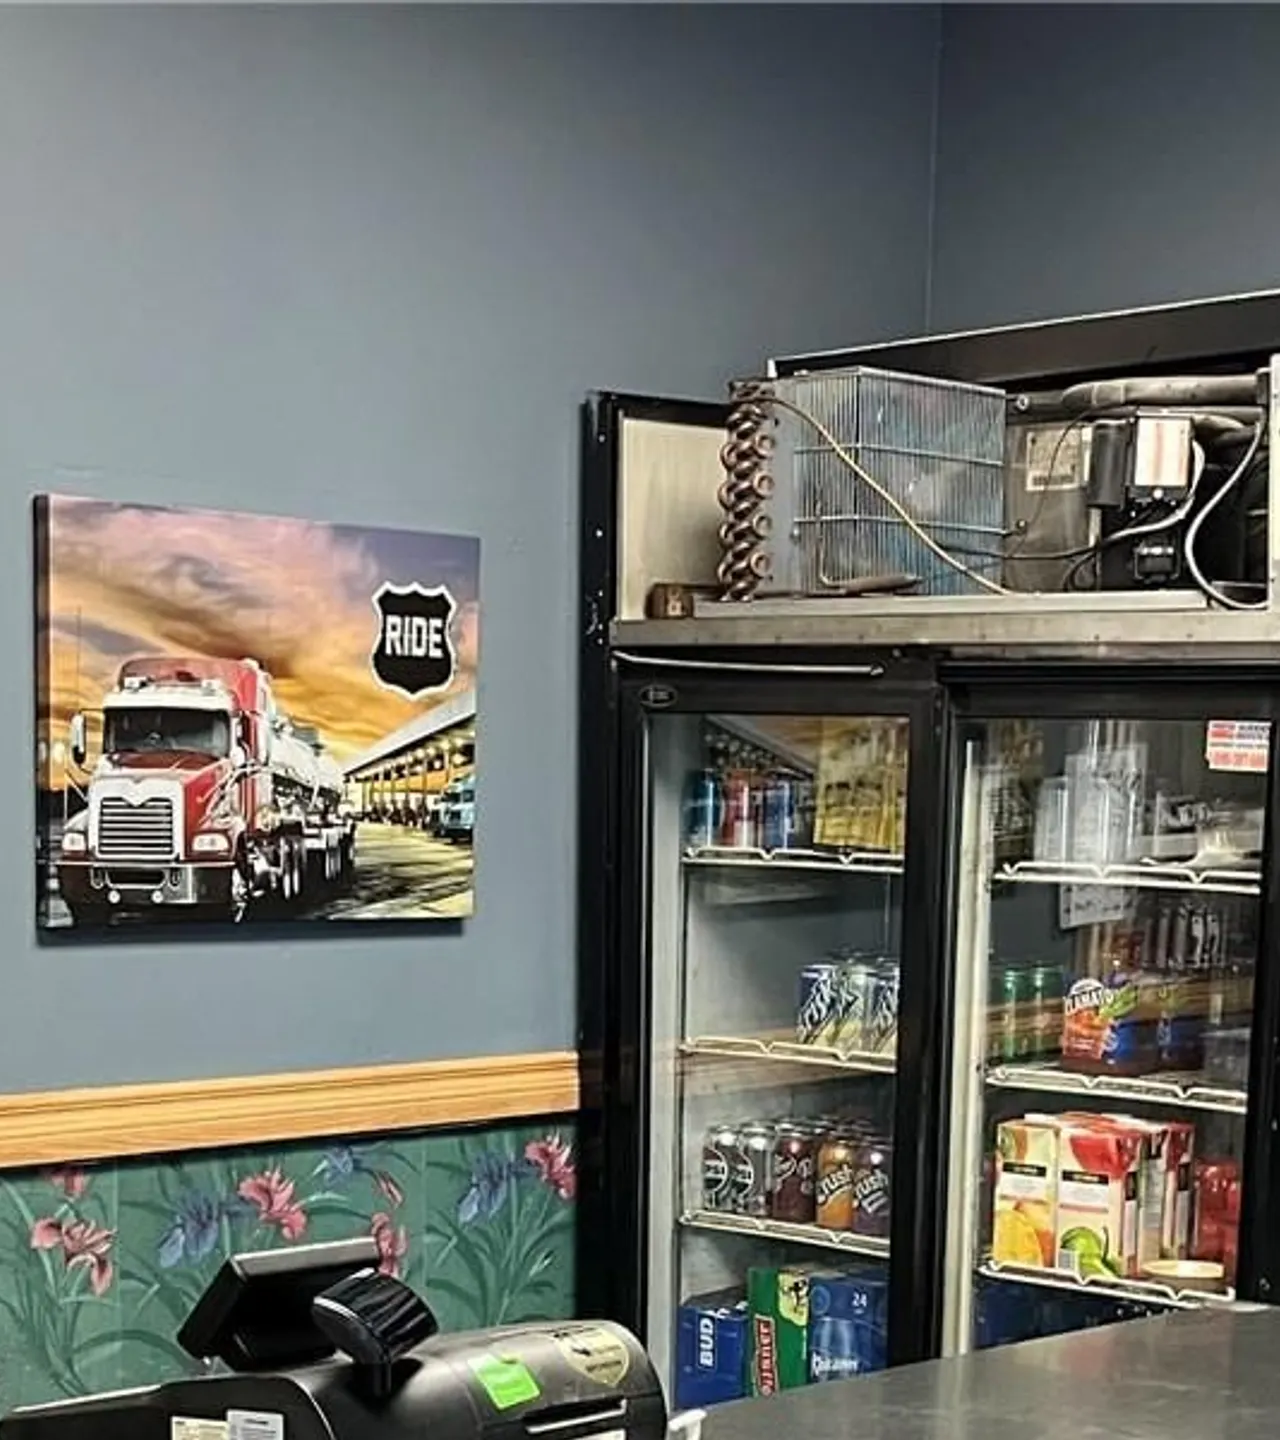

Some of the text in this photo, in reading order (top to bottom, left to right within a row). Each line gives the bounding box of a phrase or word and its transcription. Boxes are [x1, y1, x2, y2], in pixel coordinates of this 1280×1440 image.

[383, 612, 445, 660] RIDE
[851, 1291, 868, 1308] 24
[699, 1316, 715, 1367] BUD
